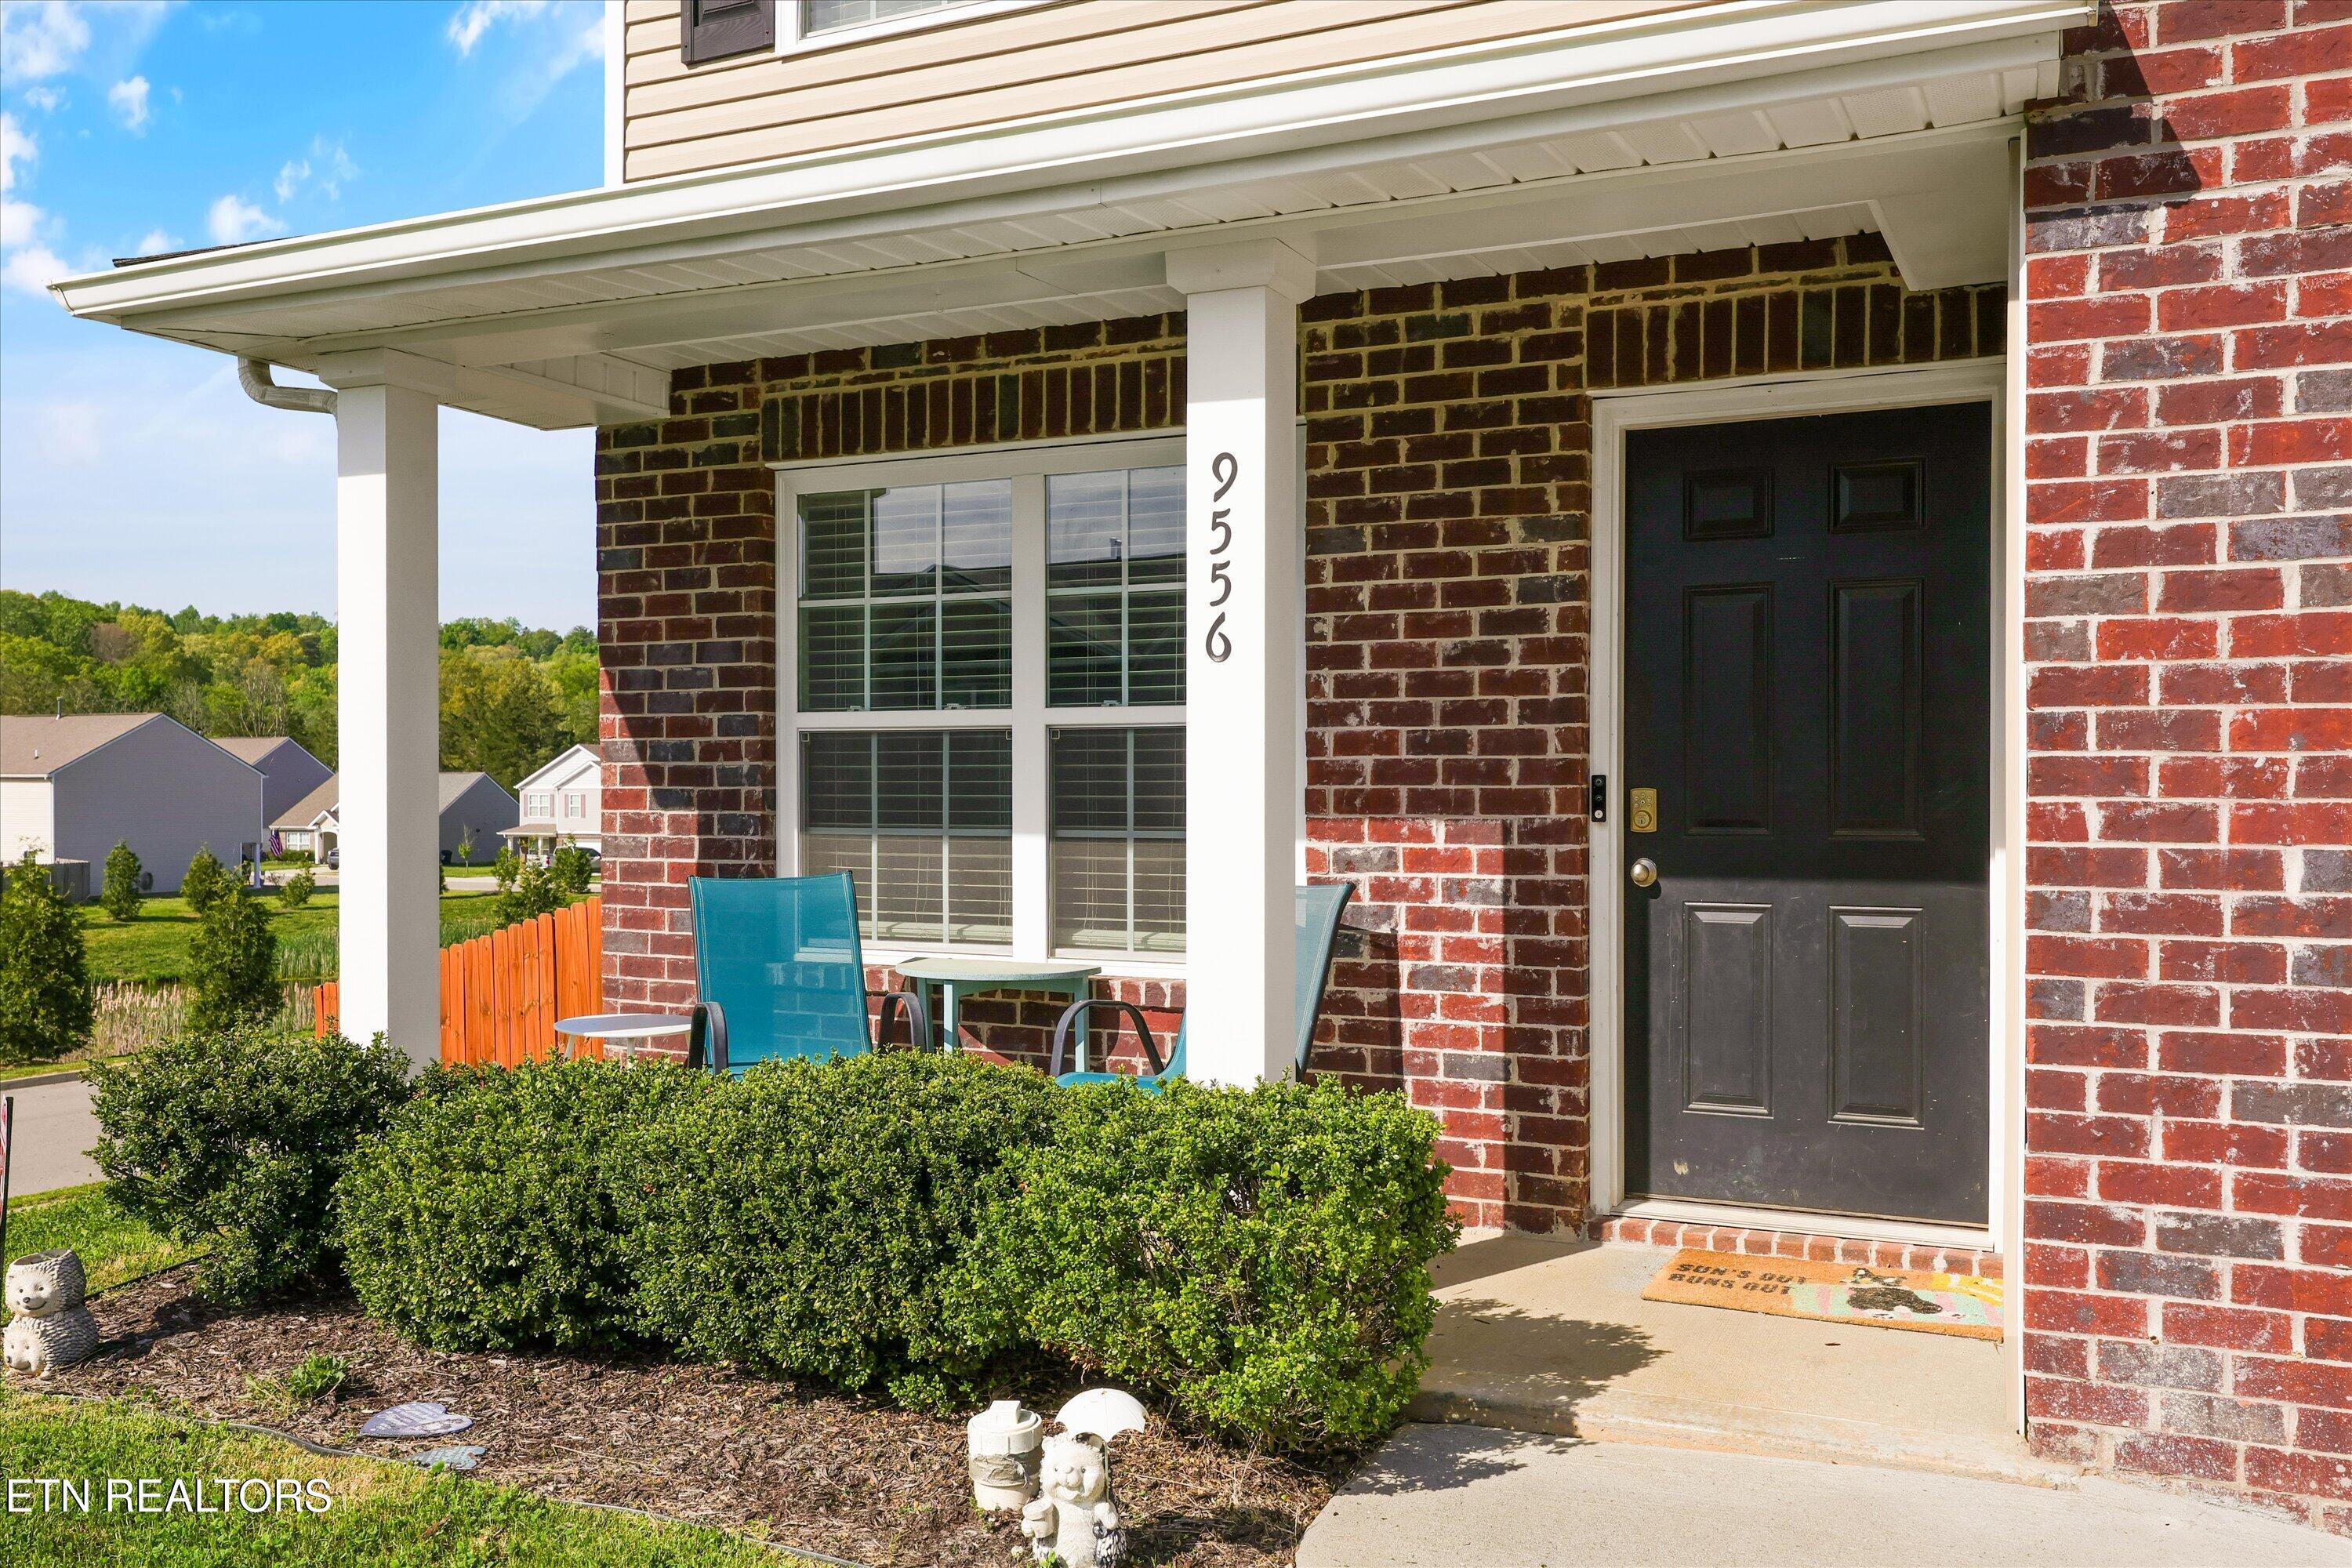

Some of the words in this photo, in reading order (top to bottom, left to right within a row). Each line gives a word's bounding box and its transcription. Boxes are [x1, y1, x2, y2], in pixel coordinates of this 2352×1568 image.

[1206, 452, 1238, 662] 9556
[1676, 1264, 1751, 1278] SUN'S
[1760, 1273, 1809, 1284] OUT
[1743, 1282, 1792, 1294] OUT
